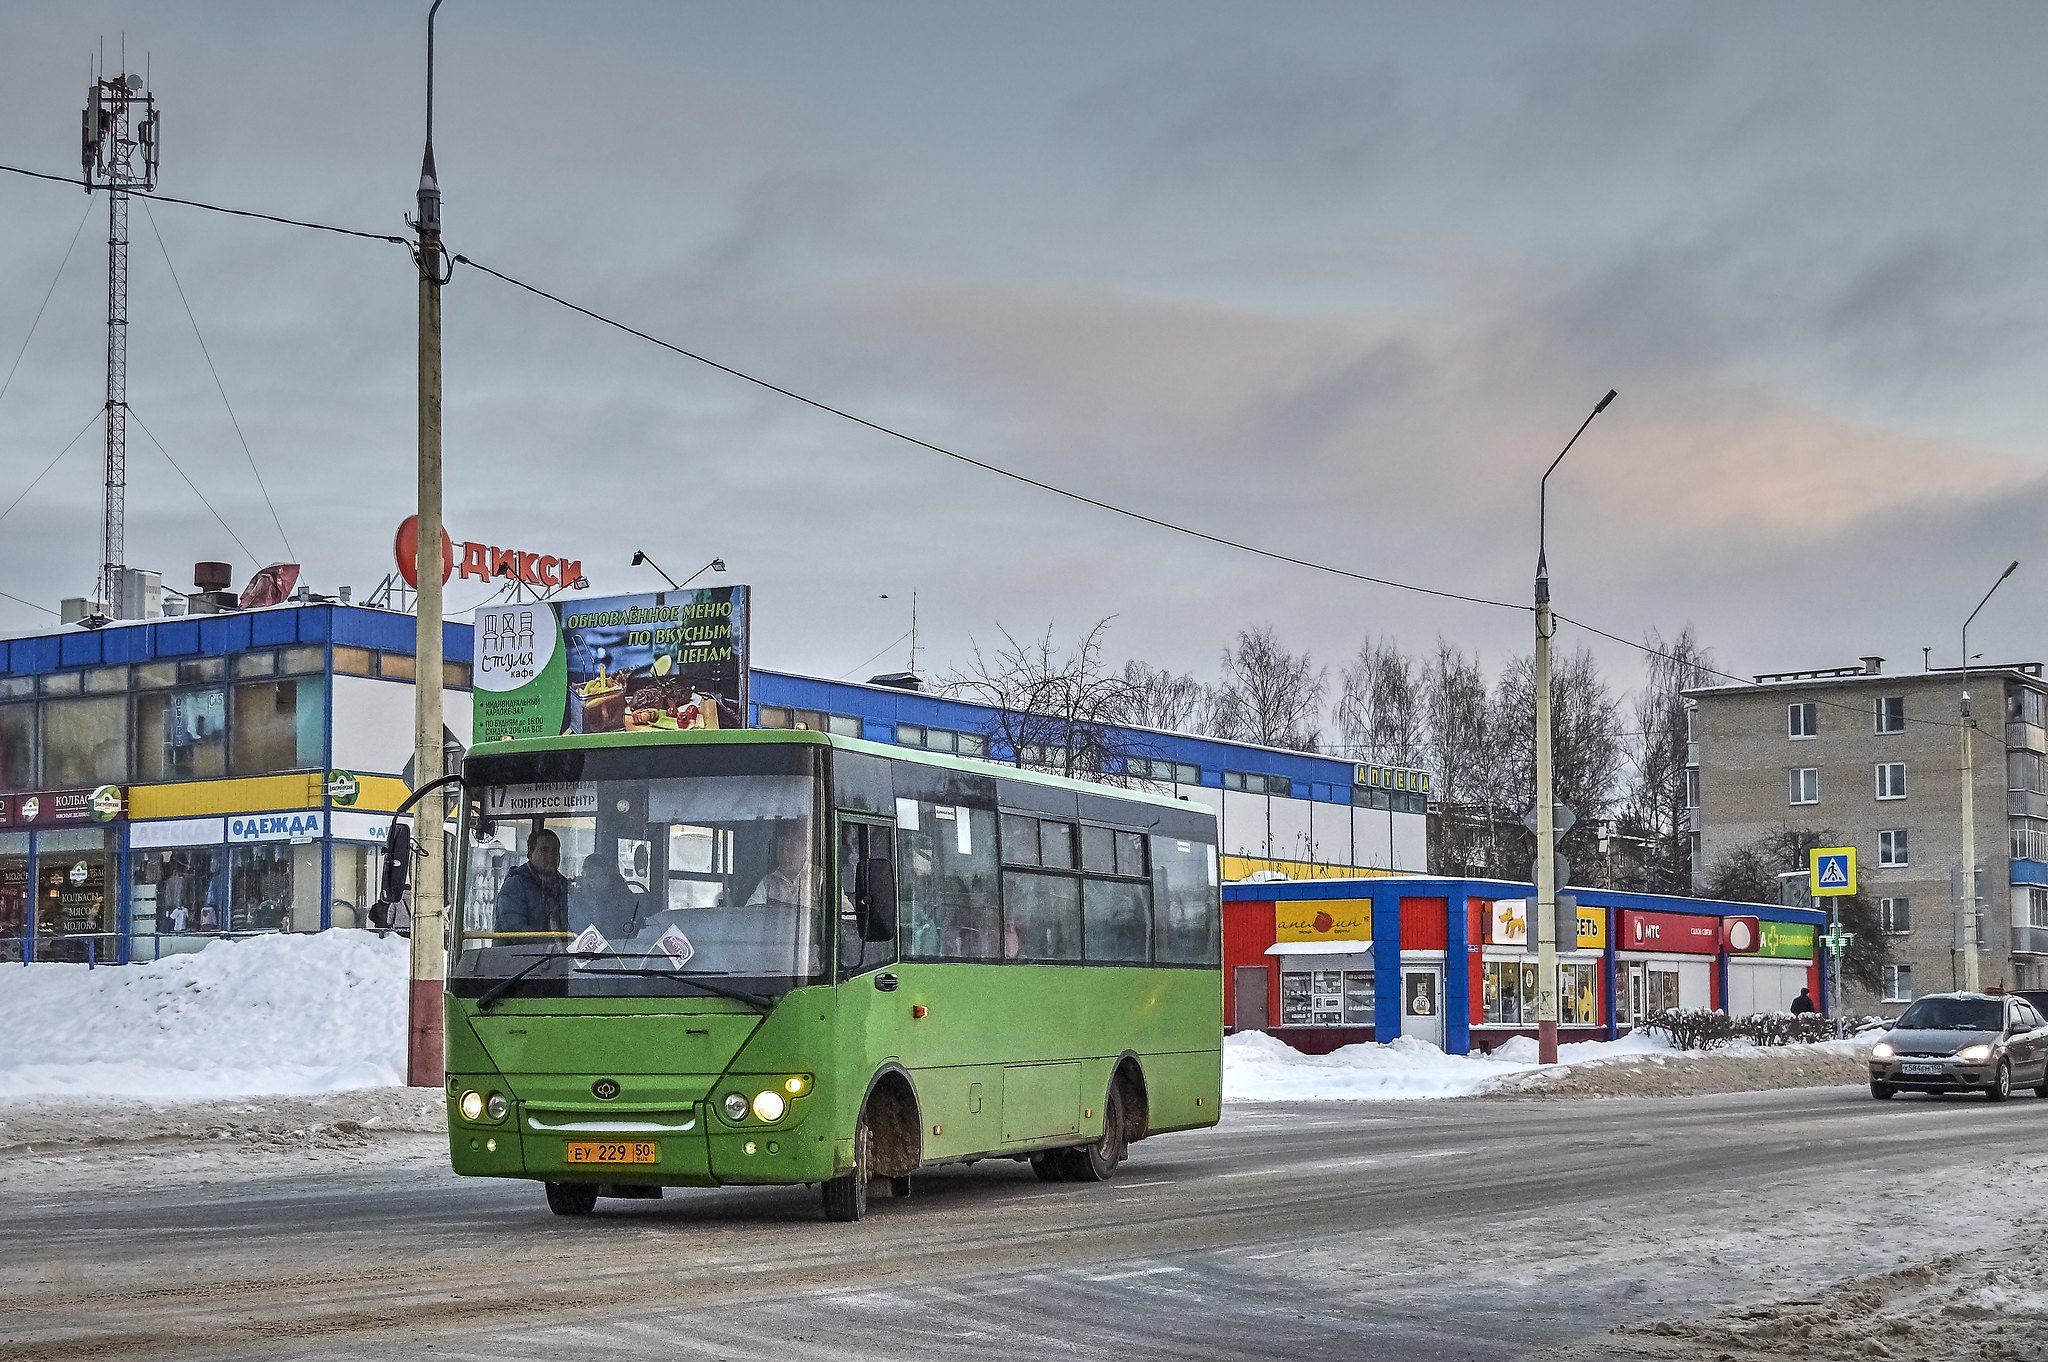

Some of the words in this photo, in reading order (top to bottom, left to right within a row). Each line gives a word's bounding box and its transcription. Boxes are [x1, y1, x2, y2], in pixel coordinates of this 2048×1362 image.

[459, 541, 583, 590] ДИКСИ
[567, 605, 680, 630] ОБНОВЛЁННОЕ
[682, 601, 734, 621] МЕНЮ
[628, 631, 651, 646] ПО
[655, 624, 733, 645] ВКУСНЫМ
[677, 647, 732, 665] ЦЕНАМ
[510, 668, 534, 679] кафе
[485, 697, 541, 709] ИНДИВИДУАЛЬНЫЙ
[485, 707, 525, 717] КАРАОКЕ-ЗАЛ
[485, 720, 494, 728] ПО
[495, 719, 518, 728] БУДНЯМ
[485, 727, 508, 736] СКИДКА
[509, 727, 521, 735] 20%
[522, 725, 531, 733] НА
[531, 725, 544, 733] ВСЕ
[1358, 767, 1430, 791] АПТЕКА
[55, 793, 91, 807] КОЛБАС
[490, 785, 508, 808] 17
[511, 797, 560, 809] КОНГРЕСС
[564, 795, 596, 807] ЦЕНТР
[232, 814, 319, 839] ОДЕЖДА
[369, 826, 391, 839] ОД
[61, 892, 99, 903] КОЛБАСЫ
[69, 907, 91, 917] МЯСО
[62, 921, 97, 931] МОЛОКО
[1645, 924, 1660, 939] МТС
[575, 1147, 592, 1160] ЕУ
[598, 1144, 627, 1161] 229
[635, 1144, 650, 1156] 50
